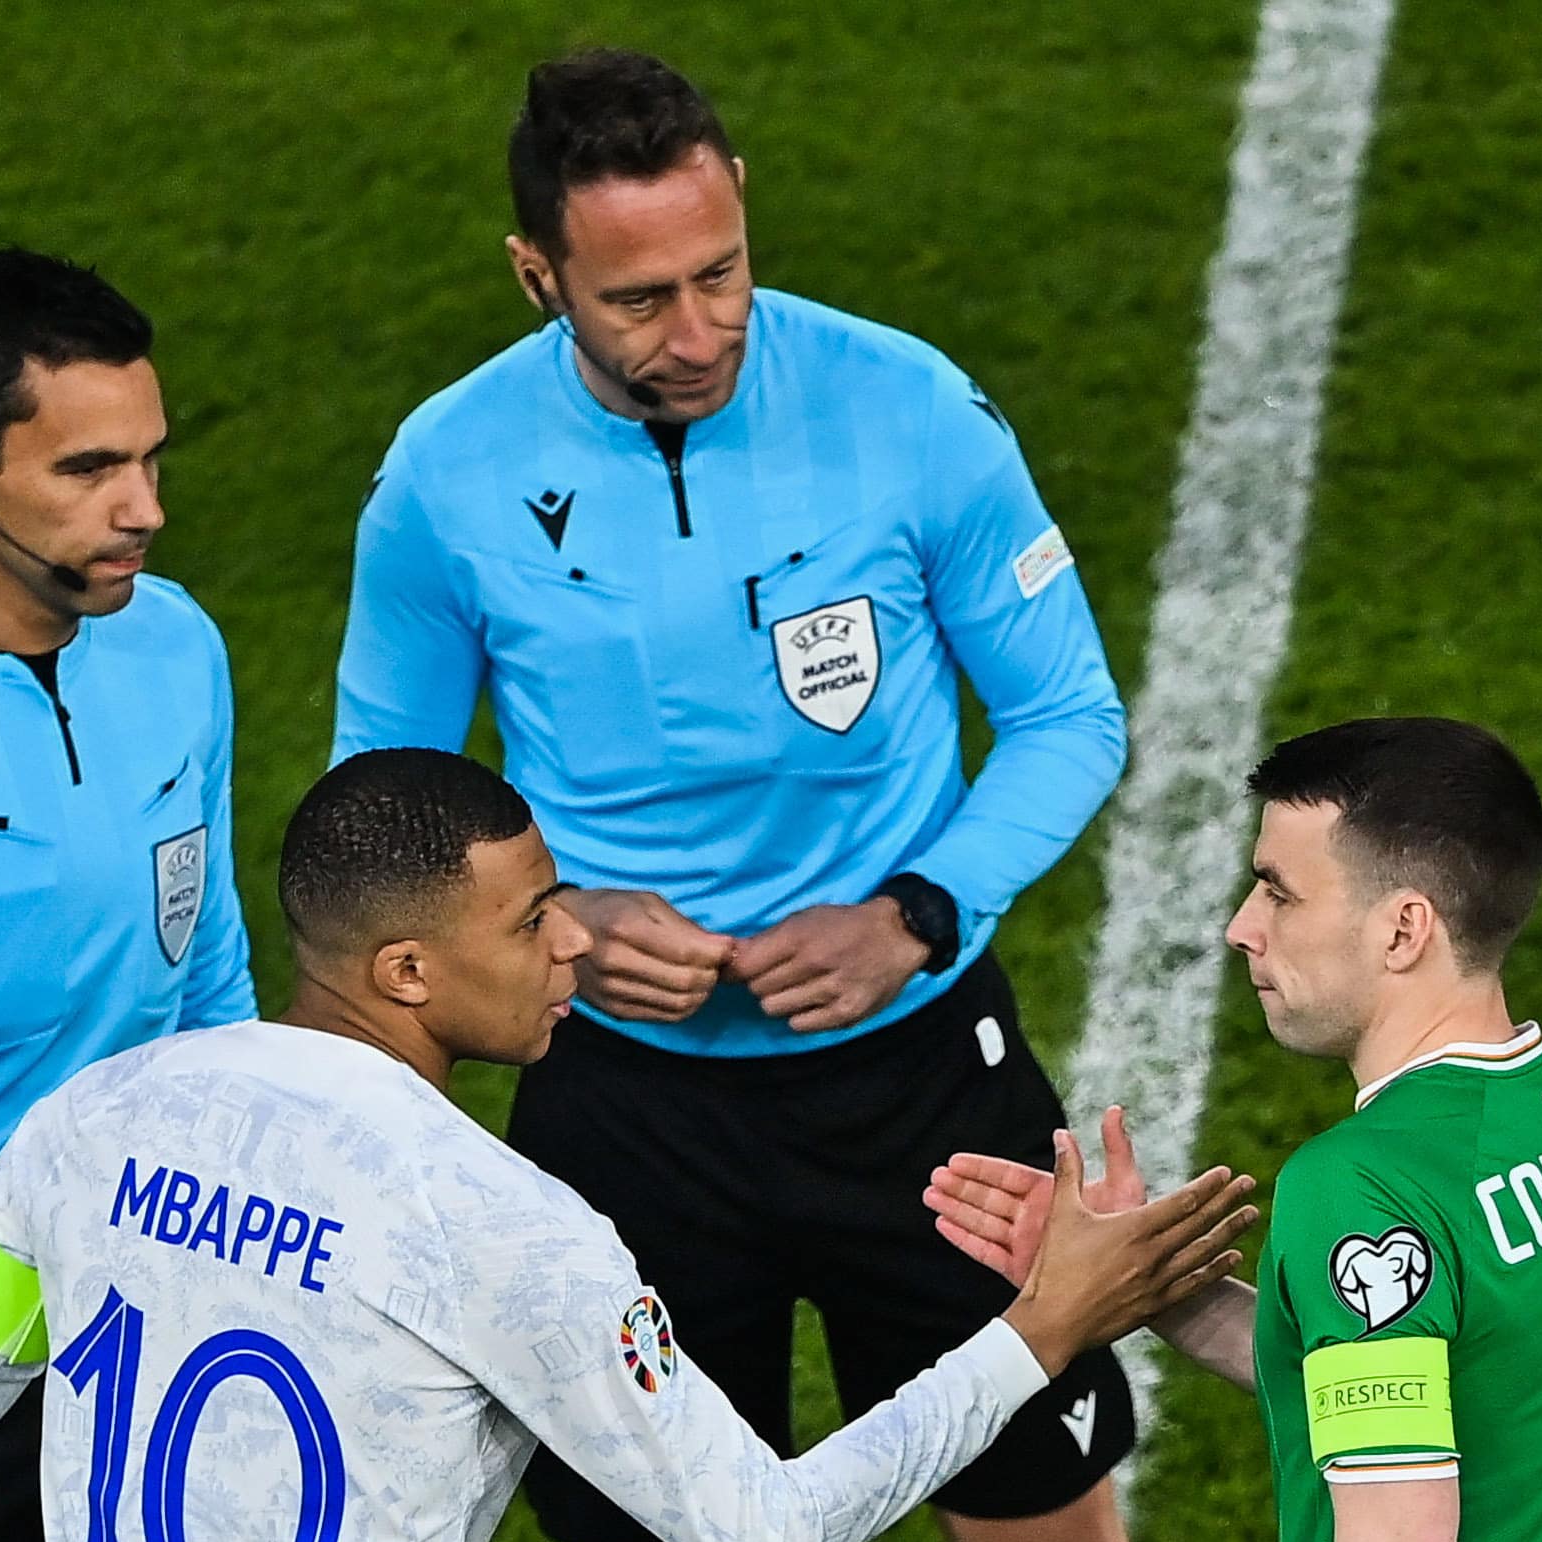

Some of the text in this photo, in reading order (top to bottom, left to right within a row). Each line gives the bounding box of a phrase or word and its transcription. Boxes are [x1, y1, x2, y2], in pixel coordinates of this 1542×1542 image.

[795, 620, 850, 649] UEFA
[802, 653, 858, 678] MATCH
[799, 670, 868, 699] OFFICIAL
[109, 1157, 345, 1293] MBAPPE
[1335, 1382, 1428, 1408] RESPECT
